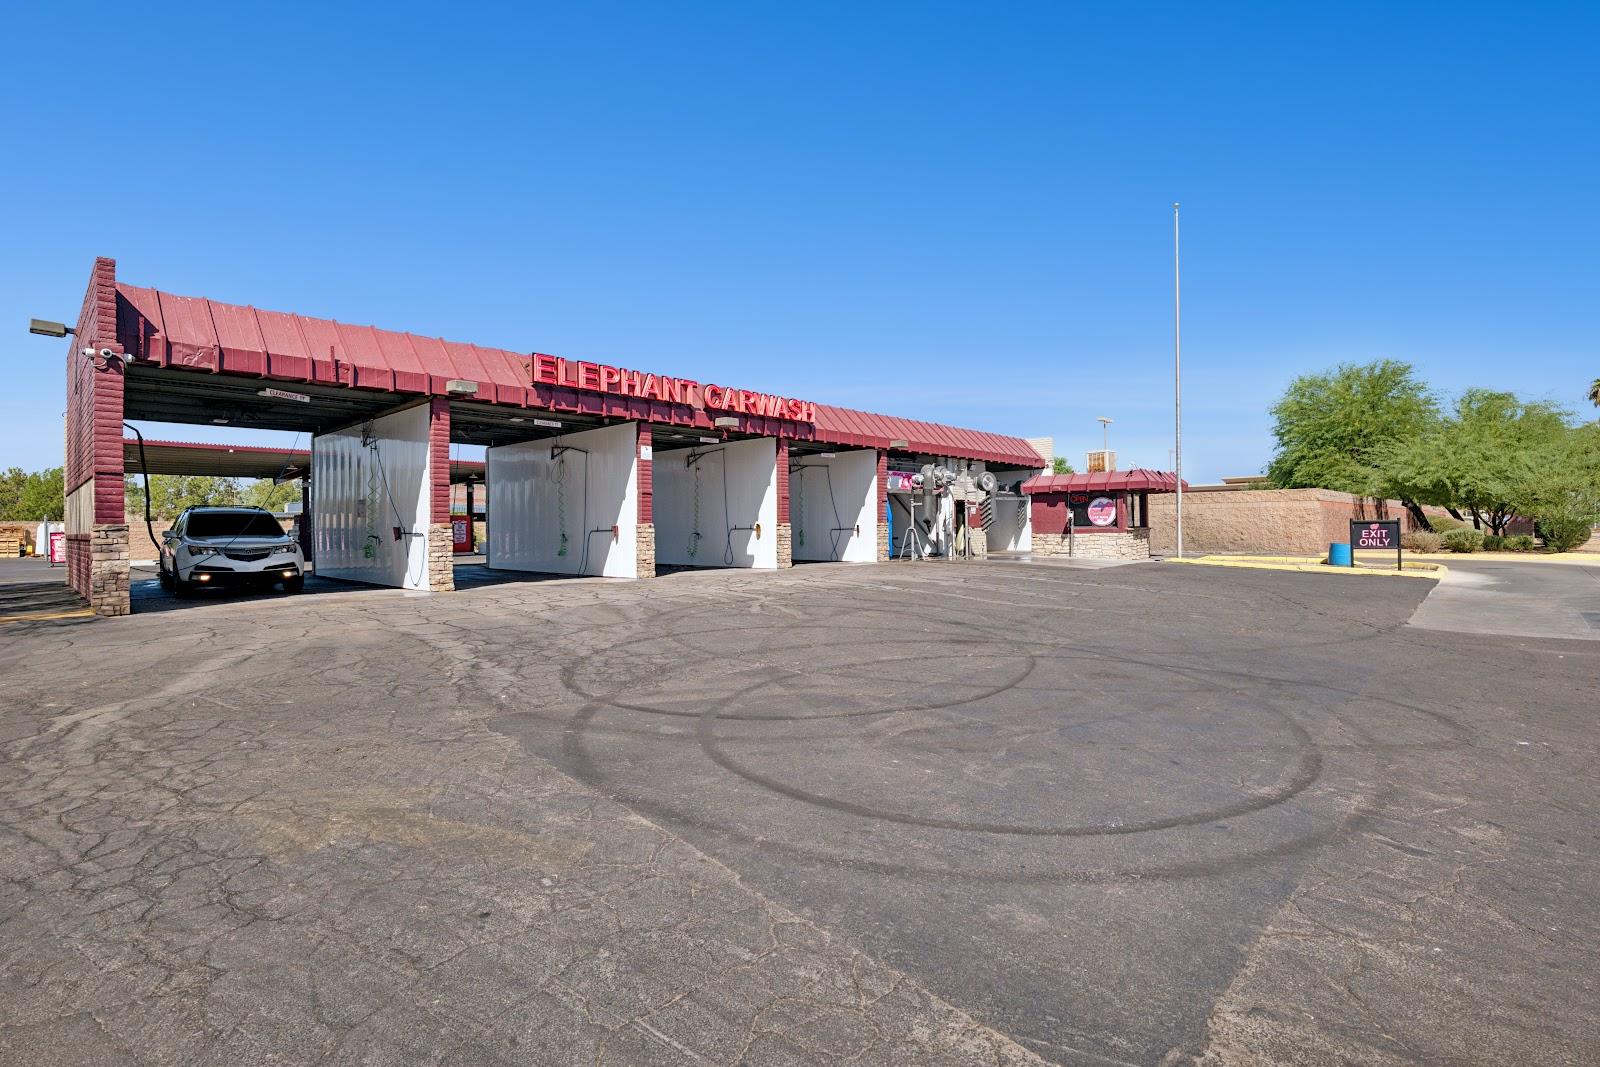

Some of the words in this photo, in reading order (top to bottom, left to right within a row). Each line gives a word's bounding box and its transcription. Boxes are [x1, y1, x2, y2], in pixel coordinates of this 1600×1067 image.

[532, 352, 698, 404] ELEPHANT
[704, 383, 816, 423] CARWASH
[1362, 529, 1388, 538] EXIT
[1359, 538, 1390, 546] ONLY
